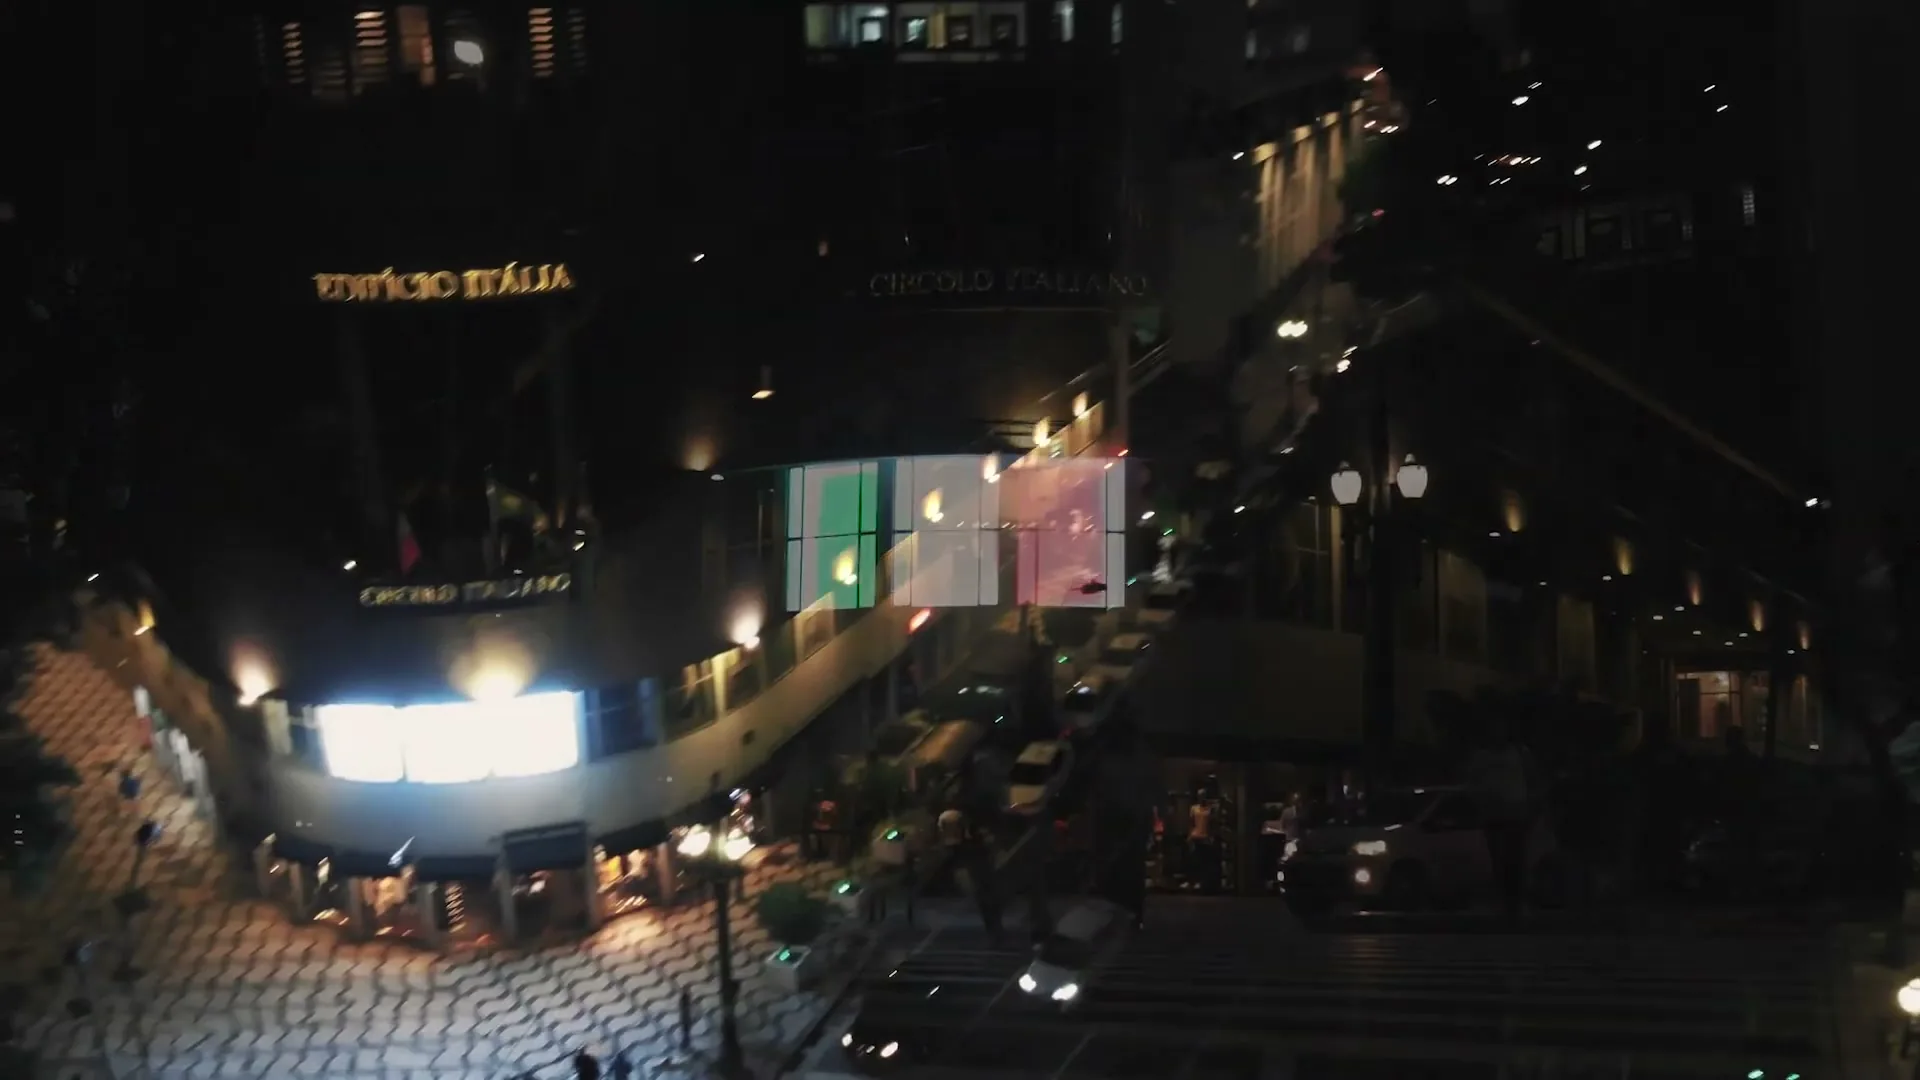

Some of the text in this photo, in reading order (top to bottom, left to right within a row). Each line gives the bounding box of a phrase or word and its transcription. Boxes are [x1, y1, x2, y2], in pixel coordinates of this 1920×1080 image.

[462, 260, 576, 301] ITÁLIA
[869, 266, 1147, 297] CIRCOLO ITALIANO
